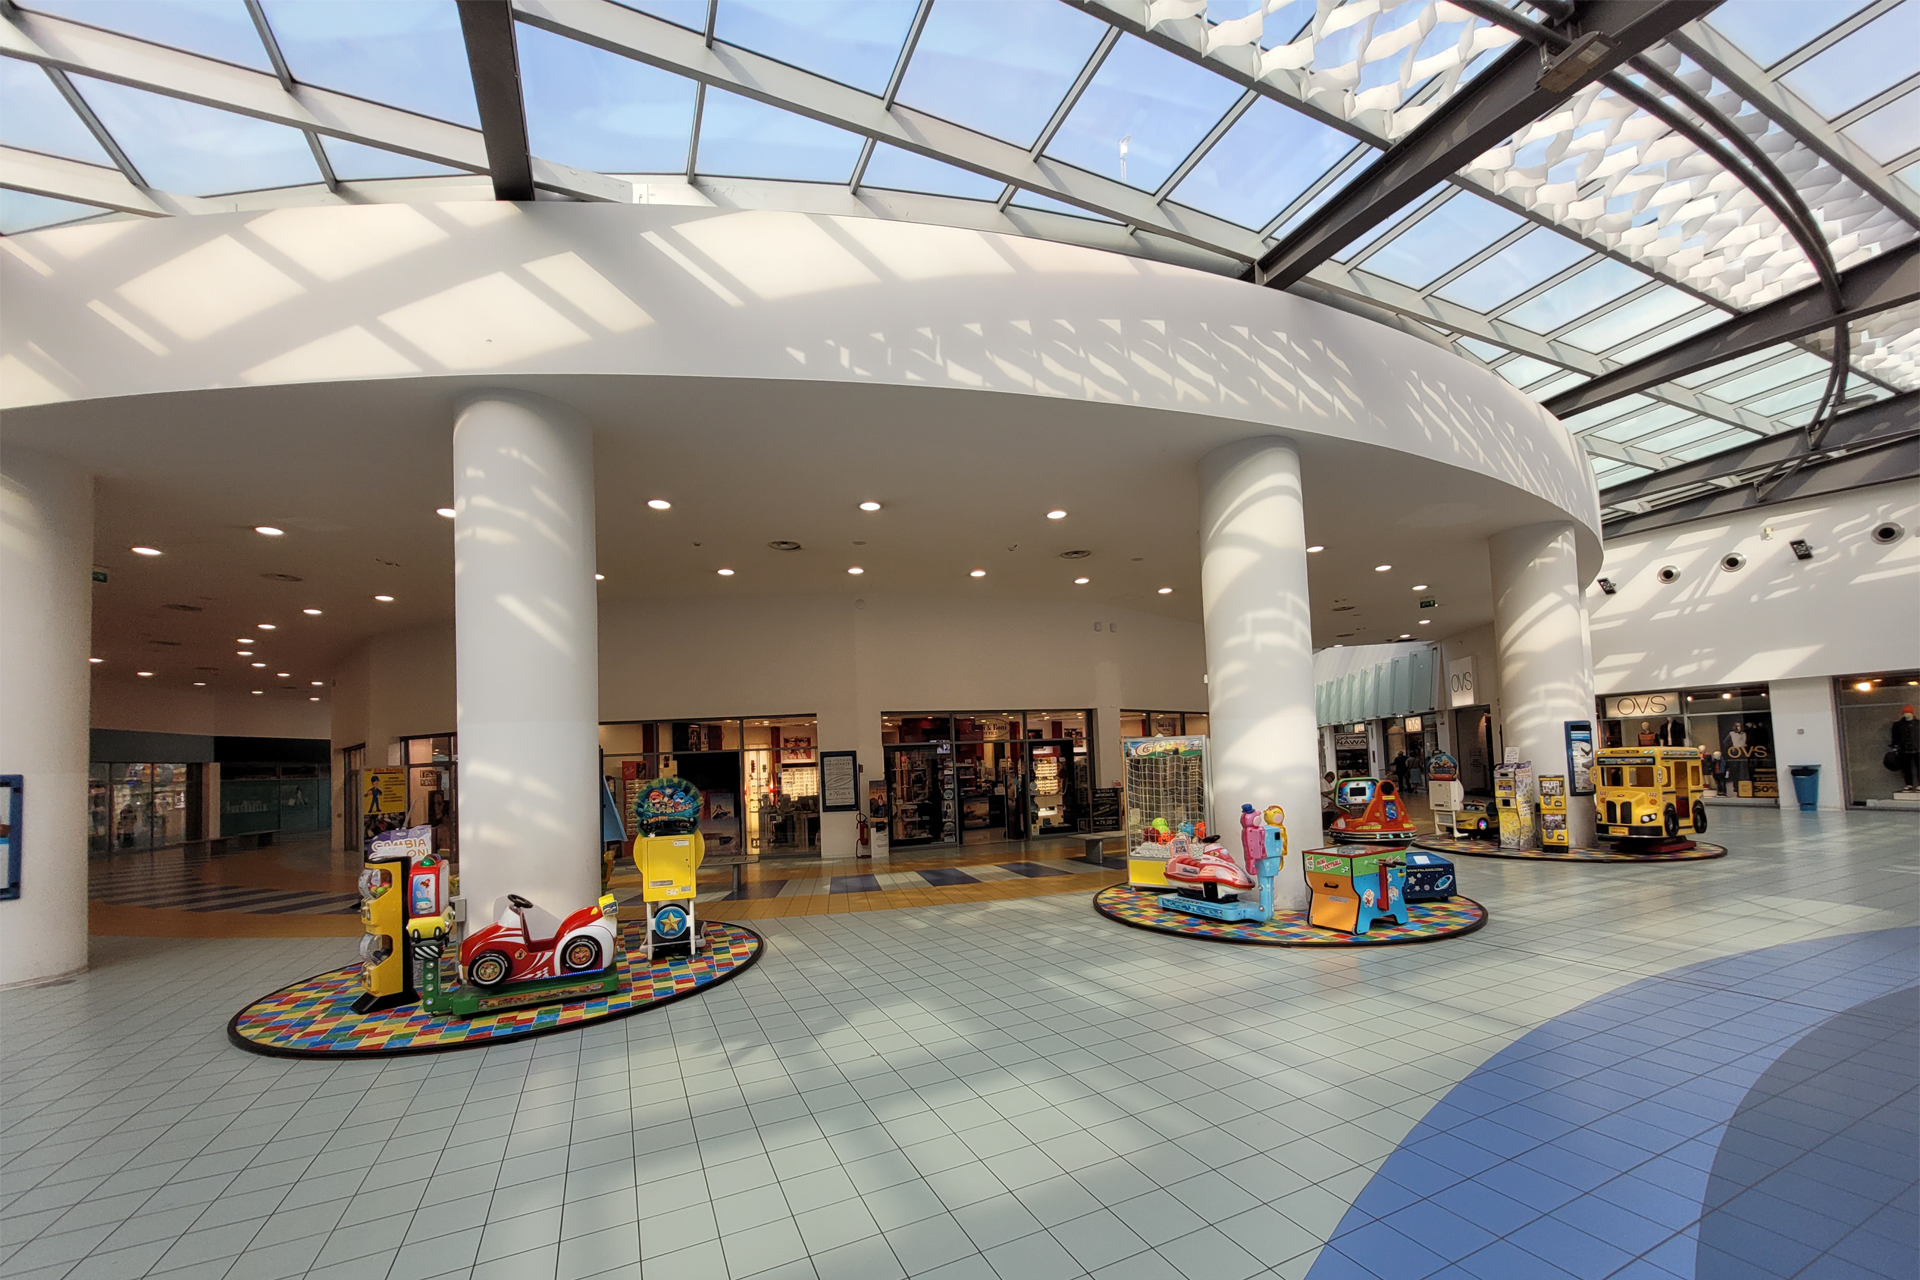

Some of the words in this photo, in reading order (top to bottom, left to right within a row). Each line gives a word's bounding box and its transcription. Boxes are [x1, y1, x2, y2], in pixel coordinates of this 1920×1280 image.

[1451, 671, 1472, 692] OVS
[1617, 695, 1667, 715] OVS
[1408, 718, 1419, 731] OVS
[1727, 745, 1768, 759] OVS
